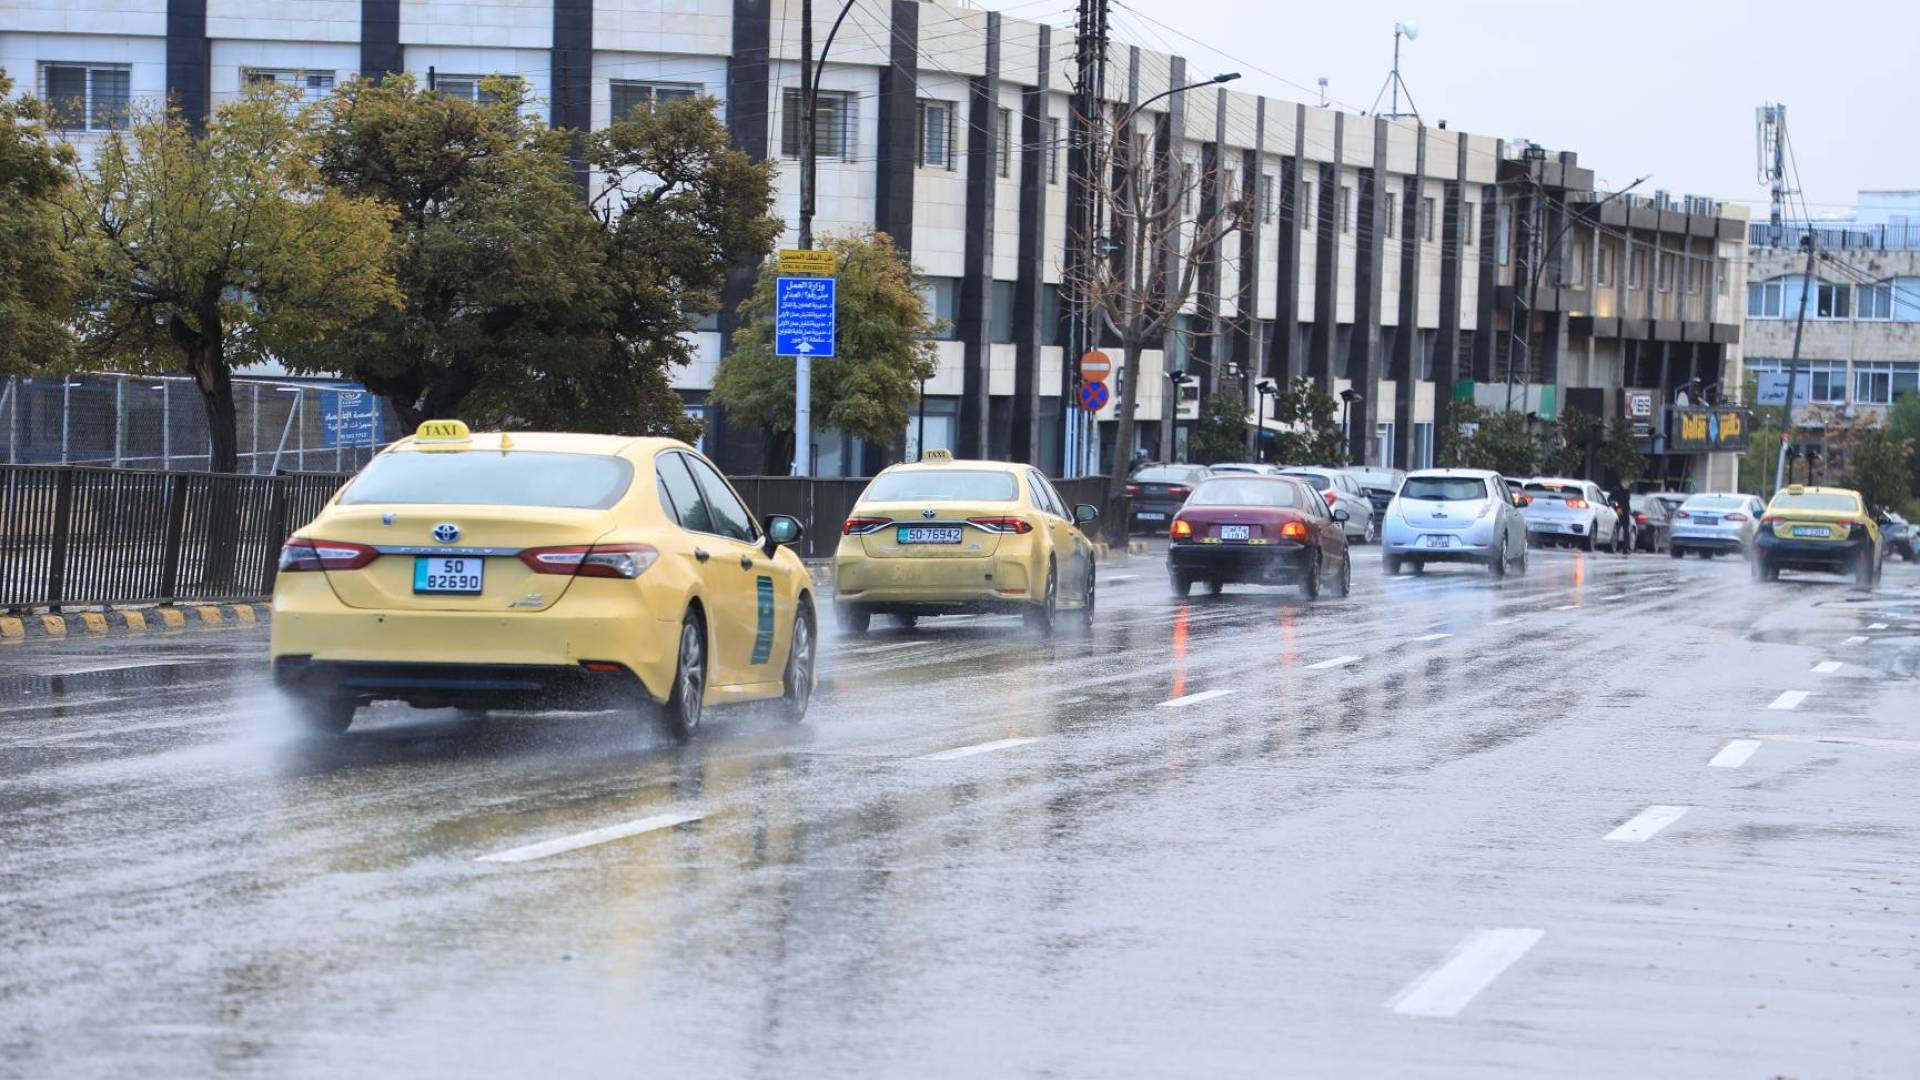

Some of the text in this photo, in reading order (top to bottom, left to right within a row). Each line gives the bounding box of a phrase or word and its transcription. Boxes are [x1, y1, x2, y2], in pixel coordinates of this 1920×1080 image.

[786, 281, 825, 293] وزارة العمل
[424, 424, 457, 436] TAXI
[909, 529, 960, 539] 50-76942
[444, 560, 464, 573] 50
[427, 575, 478, 588] 82690
